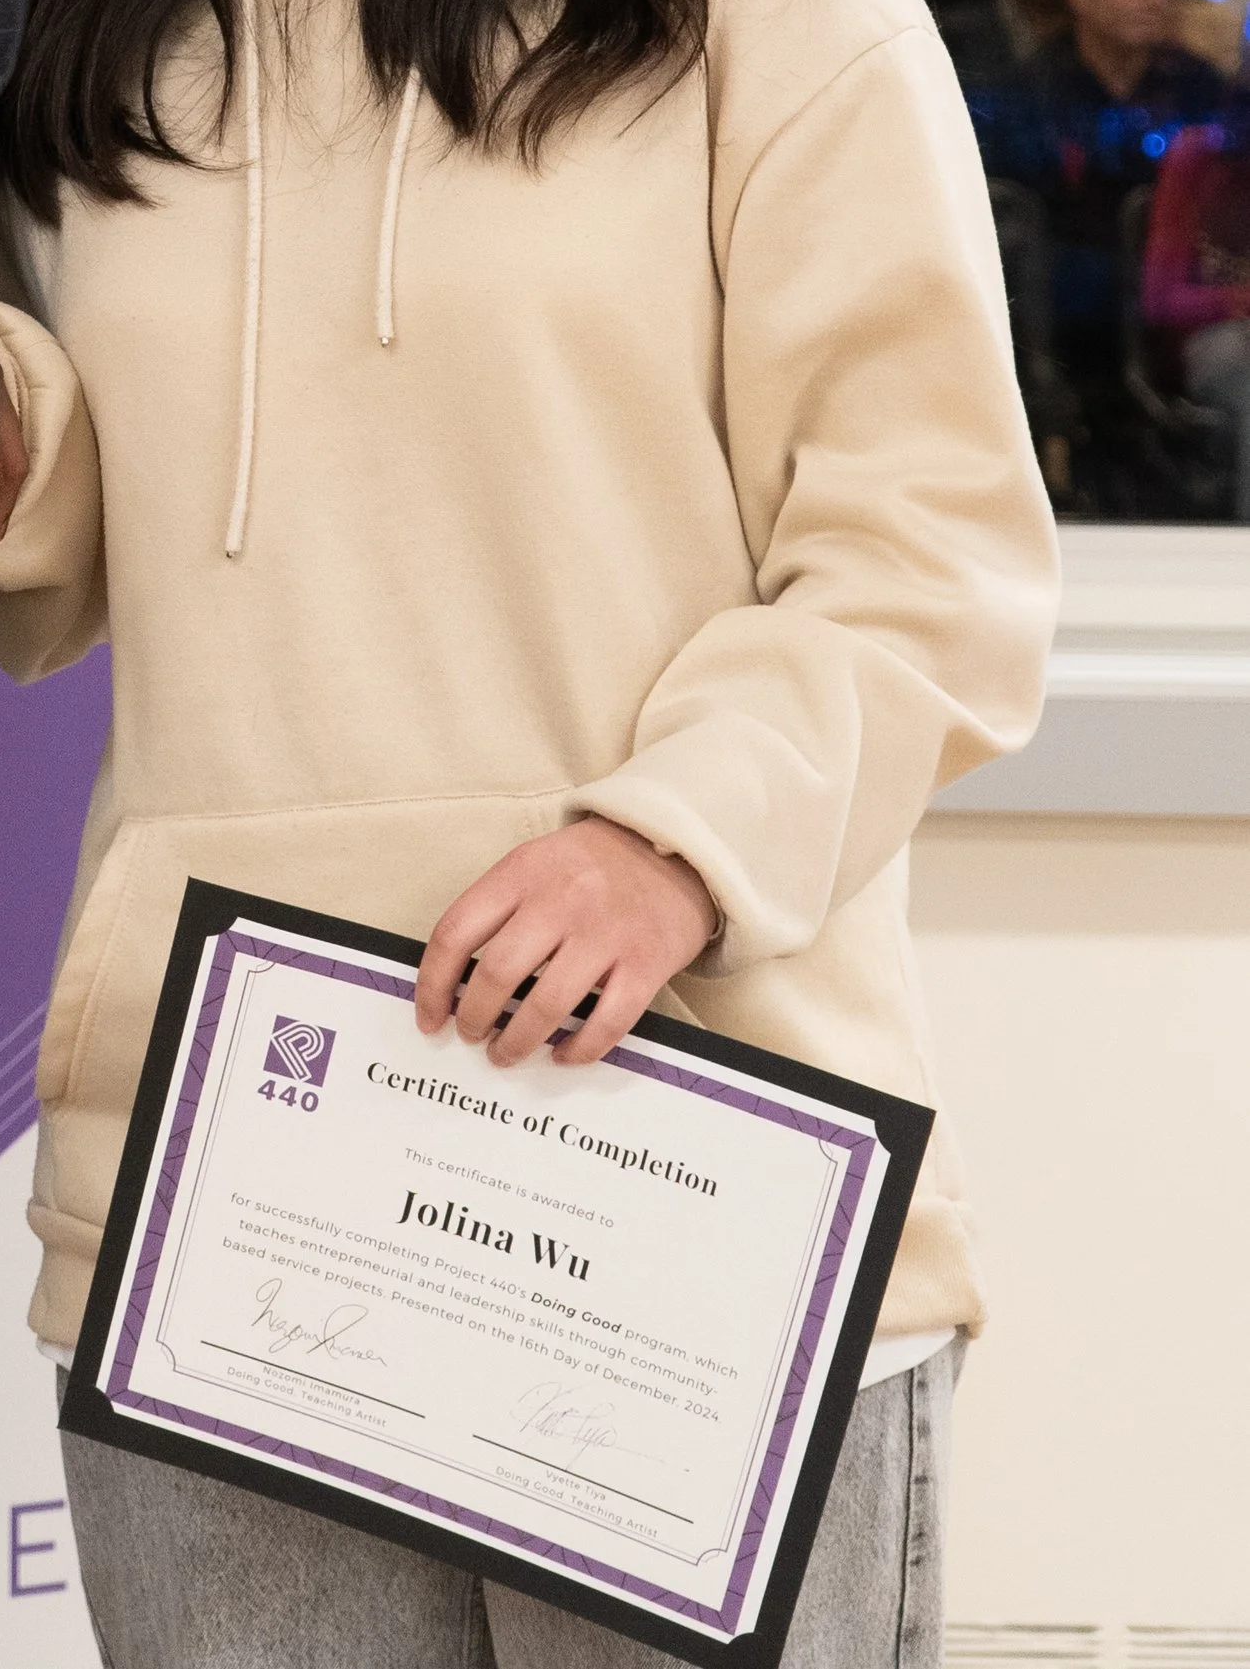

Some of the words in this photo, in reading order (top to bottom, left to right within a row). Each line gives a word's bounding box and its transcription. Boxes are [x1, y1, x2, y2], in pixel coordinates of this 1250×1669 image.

[257, 1079, 319, 1113] 440
[367, 1062, 514, 1125] Certificate
[523, 1115, 555, 1138] of
[560, 1123, 719, 1198] Completion
[405, 1148, 434, 1167] This
[437, 1159, 512, 1193] certificate
[515, 1185, 527, 1199] is
[531, 1192, 595, 1222] awarded
[599, 1214, 615, 1229] to
[396, 1190, 516, 1254] Jolina
[531, 1232, 592, 1282] Wu
[222, 1236, 267, 1260] based
[270, 1253, 321, 1276] service
[391, 1290, 464, 1324] Presented
[468, 1319, 487, 1333] on
[491, 1326, 515, 1344] the
[519, 1335, 549, 1356] 16th
[553, 1348, 582, 1370] Day
[584, 1363, 600, 1375] of
[230, 1192, 252, 1207] for
[254, 1202, 343, 1238] successfully
[346, 1230, 430, 1268] completing
[434, 1257, 486, 1287] Project
[490, 1276, 527, 1299] 440's
[531, 1291, 577, 1319] Doing
[581, 1311, 622, 1333] Good
[695, 1355, 739, 1380] which
[239, 1219, 296, 1245] teaches
[300, 1238, 414, 1284] entrepreneurial
[417, 1276, 446, 1295] and
[449, 1287, 525, 1324] leadership
[529, 1317, 565, 1338] skills
[569, 1331, 626, 1361] through
[630, 1355, 718, 1397] community-
[227, 1366, 261, 1385] Doing
[301, 1391, 353, 1416] Teaching
[355, 1410, 387, 1427] Artist
[262, 1365, 307, 1387] Nozomi
[309, 1379, 361, 1406] Imamura
[495, 1466, 530, 1487] Doing
[571, 1495, 623, 1525] Teaching
[626, 1519, 659, 1538] Artist
[545, 1469, 581, 1490] Vyette
[585, 1484, 607, 1501] Tiya
